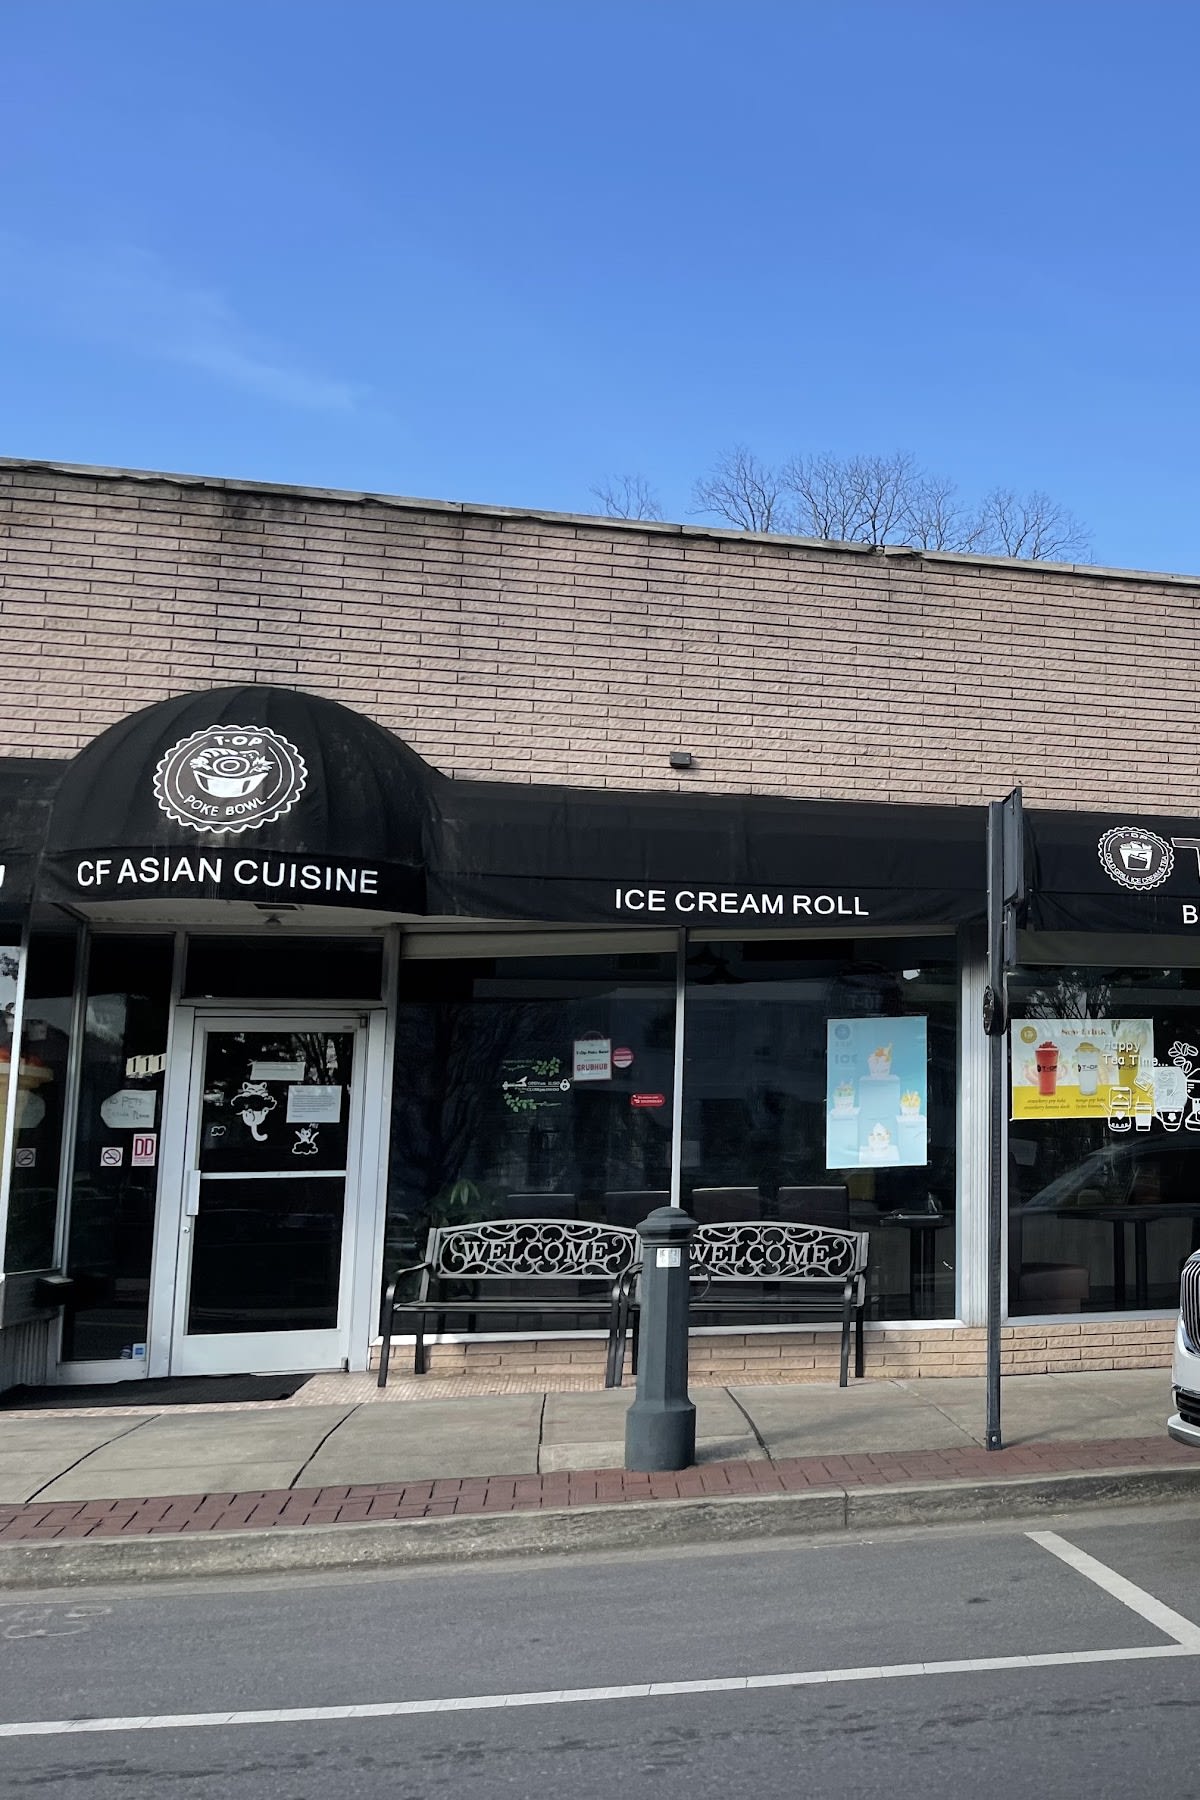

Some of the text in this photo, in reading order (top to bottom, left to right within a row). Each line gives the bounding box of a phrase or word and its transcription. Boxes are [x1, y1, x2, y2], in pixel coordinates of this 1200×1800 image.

[213, 735, 263, 746] T-OP
[183, 794, 266, 817] POKE BOWL
[77, 857, 379, 895] CF ASIAN CUISINE
[615, 888, 869, 916] ICE CREAM ROLL
[1103, 1040, 1141, 1053] Happy
[1102, 1055, 1126, 1066] Tea
[462, 1241, 609, 1263] WELCOME
[689, 1243, 830, 1265] WELCOME
